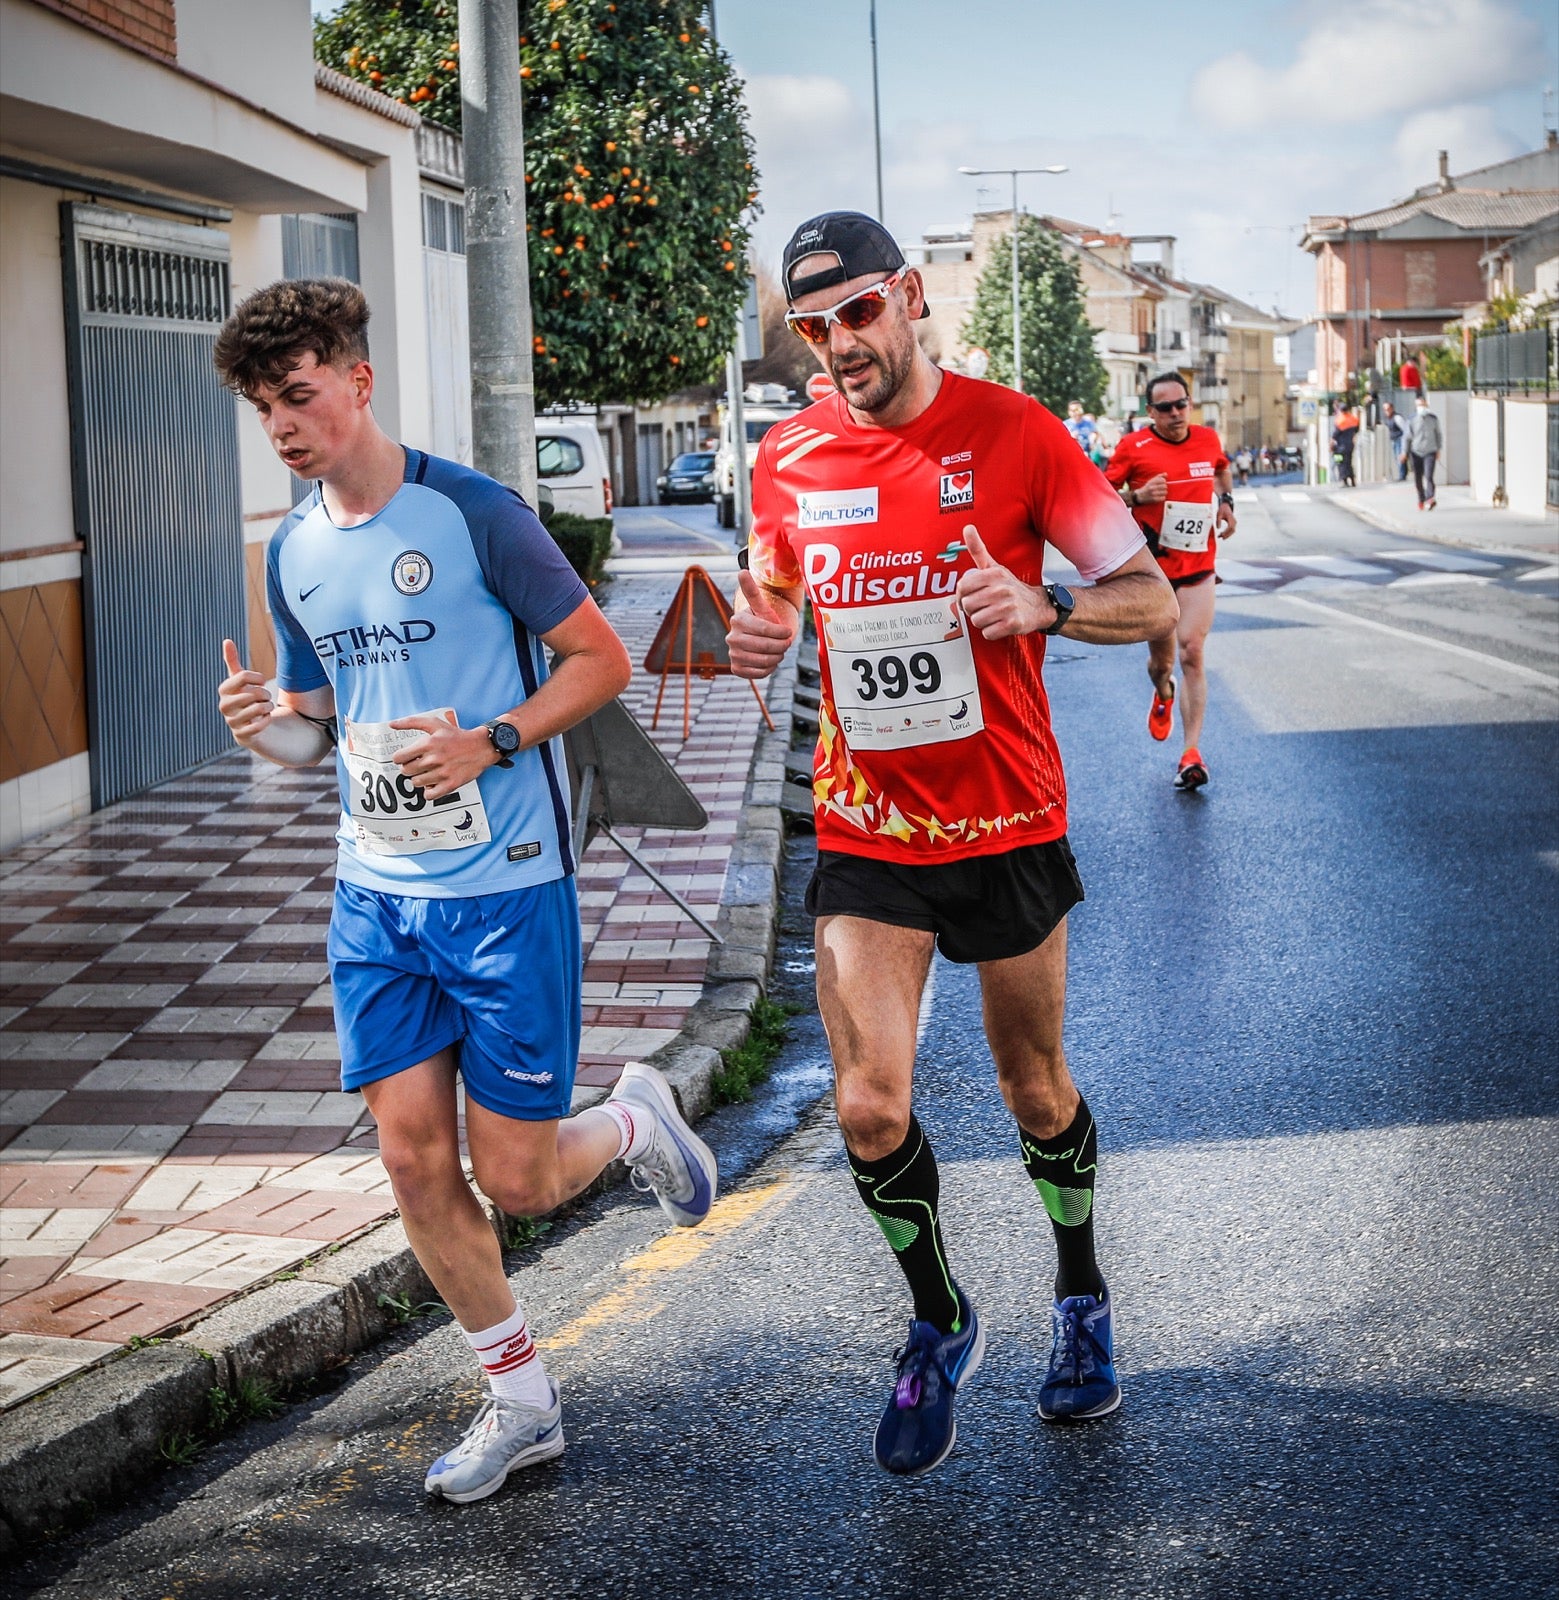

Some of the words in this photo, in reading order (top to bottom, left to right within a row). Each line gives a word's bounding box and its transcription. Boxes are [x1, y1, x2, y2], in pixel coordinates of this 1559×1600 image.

[943, 477, 949, 494] I
[941, 490, 973, 505] MOVE
[939, 503, 974, 515] RUNNING
[1174, 519, 1204, 535] 428
[396, 555, 426, 570] MANCHESTER
[850, 550, 923, 571] Clínicas
[804, 543, 979, 604] Polisalu
[889, 618, 898, 629] DE
[900, 616, 922, 628] FONDO
[923, 612, 944, 625] 2022
[314, 619, 436, 658] ETIHAD
[338, 648, 410, 669] AIRWAYS
[851, 651, 942, 702] 399
